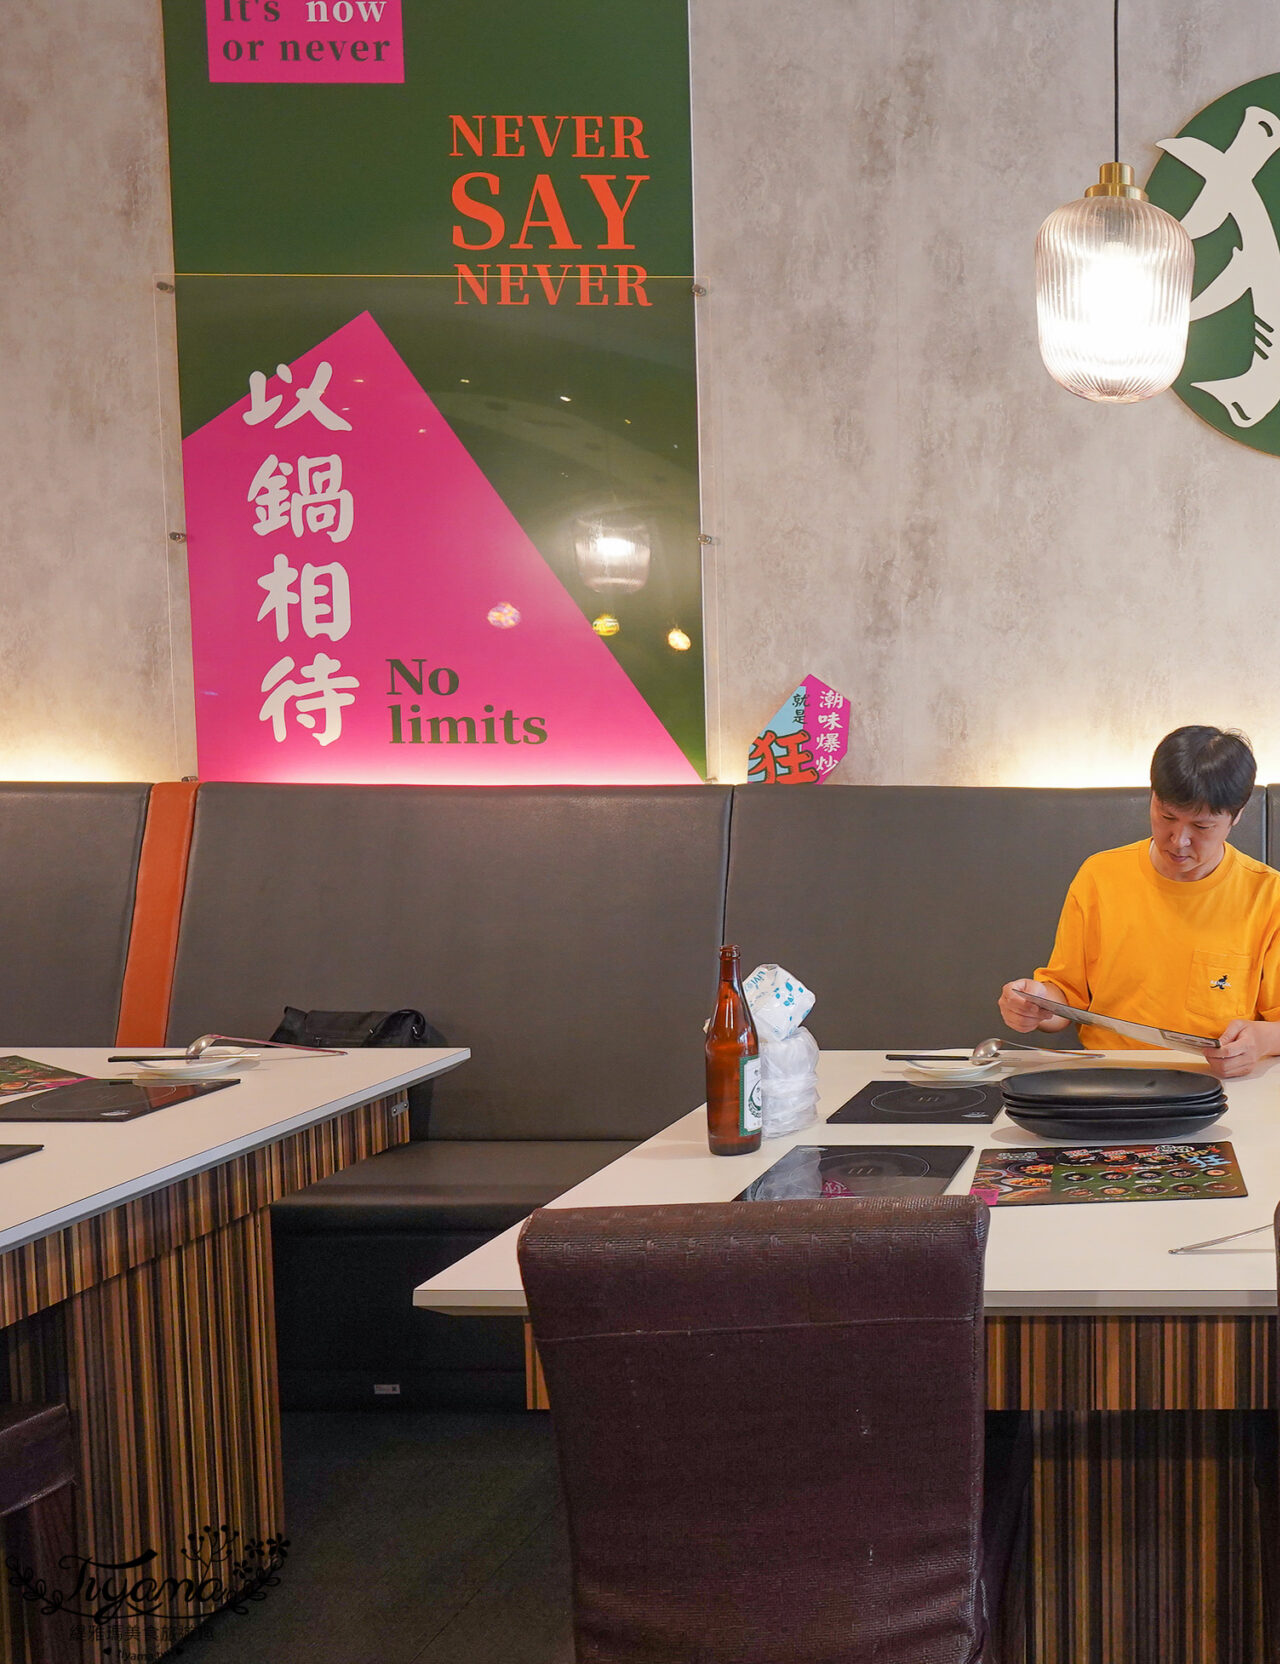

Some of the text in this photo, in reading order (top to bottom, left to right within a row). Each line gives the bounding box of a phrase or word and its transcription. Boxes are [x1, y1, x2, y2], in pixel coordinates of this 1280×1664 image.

[222, 0, 387, 23] It's now
[222, 40, 390, 62] or never
[448, 115, 650, 159] NEVER
[451, 171, 651, 251] SAY
[453, 263, 653, 307] NEVER
[242, 361, 360, 747] 以鍋相待
[386, 658, 460, 697] No
[387, 704, 549, 746] limits
[792, 693, 811, 725] 就是
[815, 689, 844, 776] 潮味爆炒
